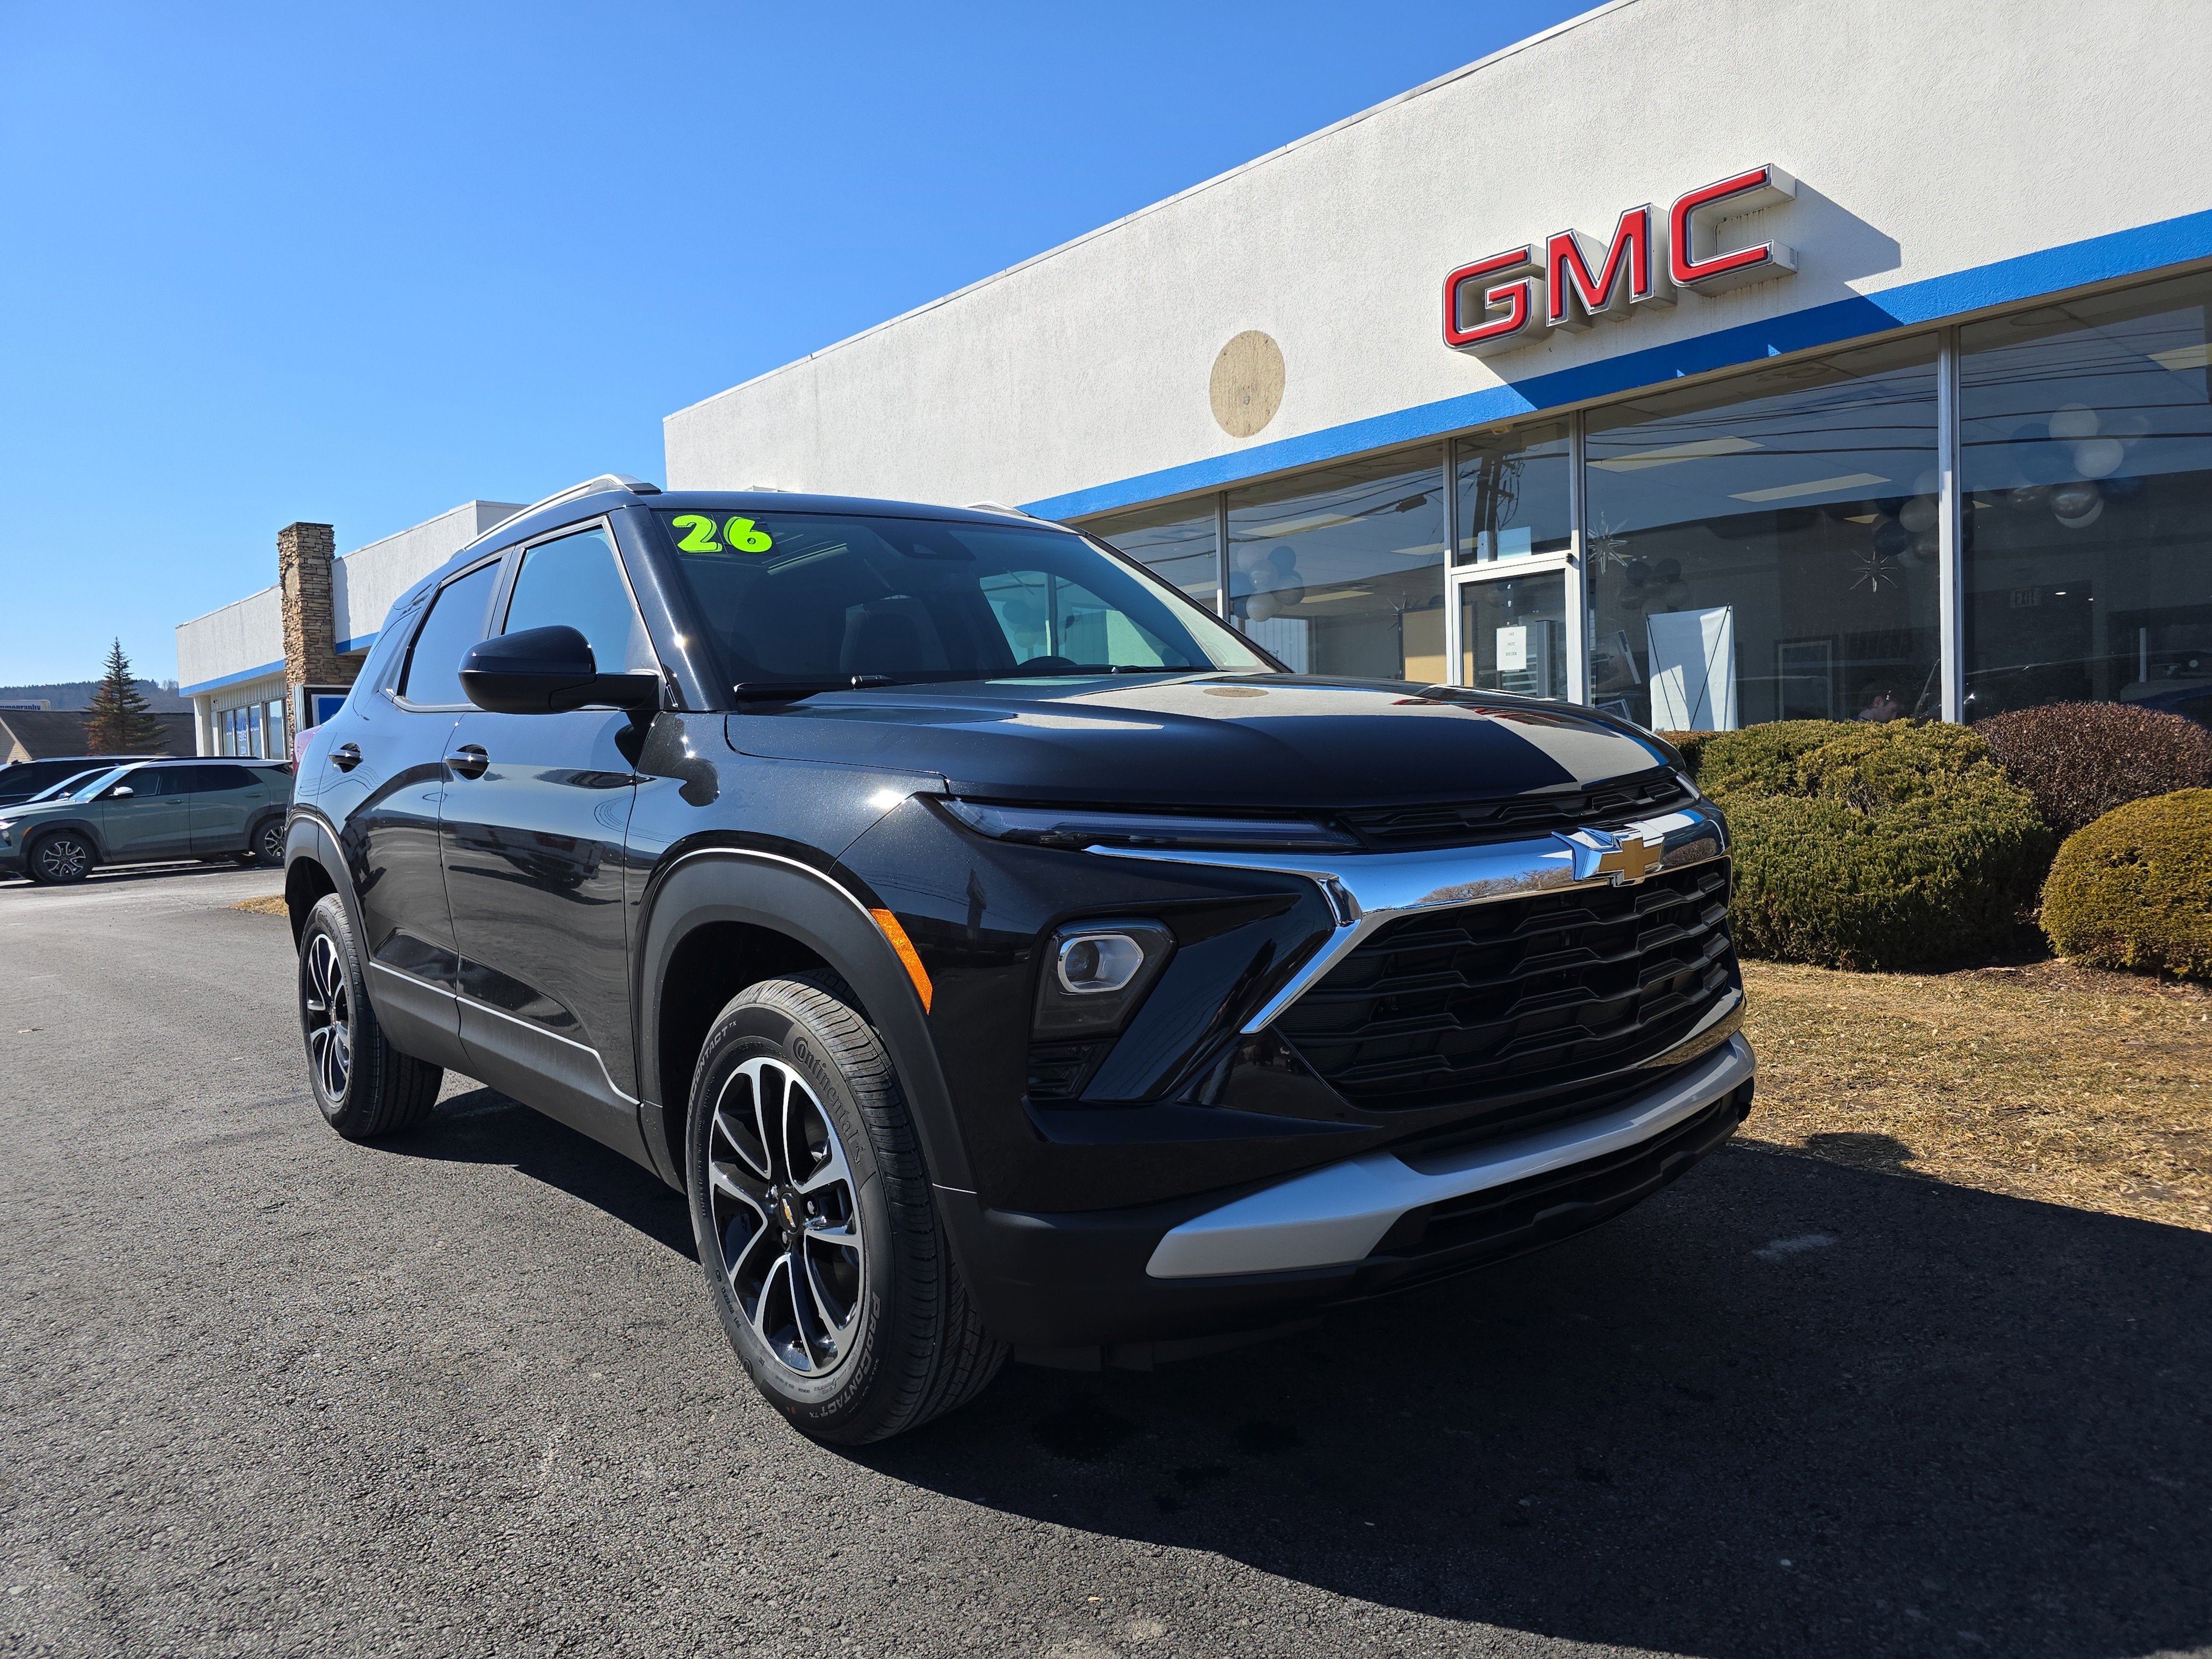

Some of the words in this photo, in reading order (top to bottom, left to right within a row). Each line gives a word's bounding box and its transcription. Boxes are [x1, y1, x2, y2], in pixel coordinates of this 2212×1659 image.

[1442, 163, 1784, 353] GMC
[672, 515, 772, 553] 26
[2015, 589, 2035, 606] EXIT
[793, 1037, 859, 1142] Continental
